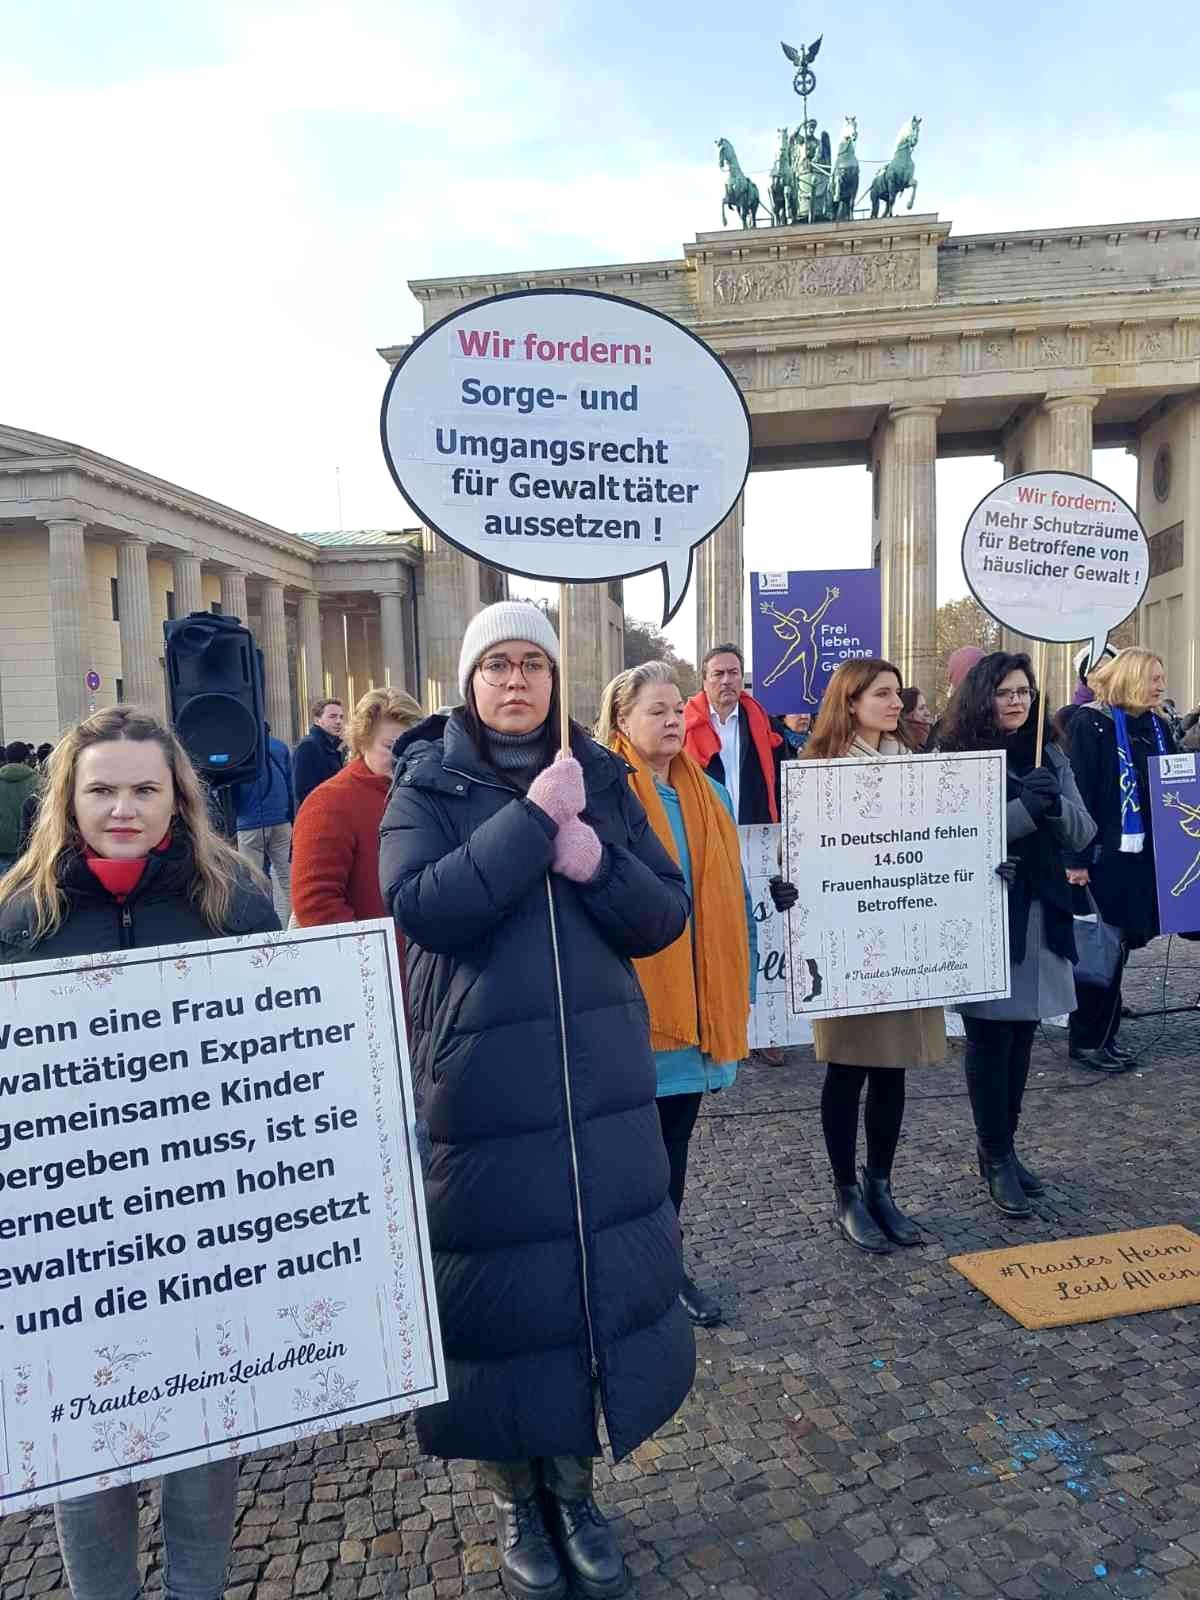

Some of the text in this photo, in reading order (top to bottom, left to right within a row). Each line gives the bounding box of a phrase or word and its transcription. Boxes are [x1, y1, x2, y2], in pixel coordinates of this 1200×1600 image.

[458, 330, 652, 365] Wir fordern:
[461, 378, 638, 414] Sorge- und
[436, 428, 669, 466] Umgangsrecht
[452, 468, 699, 504] für Gewalttäter
[1018, 486, 1117, 513] Wir fordern:
[485, 514, 662, 541] aussetzen !
[985, 511, 1139, 541] Mehr Schutzräume
[979, 532, 1128, 562] für Betroffene von
[983, 556, 1139, 585] häuslicher Gewalt !
[821, 624, 847, 635] Frei
[822, 637, 860, 647] leben
[839, 648, 872, 659] ohne
[820, 825, 978, 848] In Deutschland fehlen
[874, 850, 924, 866] 14.600
[822, 868, 975, 893] Frauenhausplätze für
[857, 896, 938, 914] Betroffene.
[89, 1007, 162, 1037] eine
[172, 996, 245, 1026] Frau
[255, 983, 322, 1013] dem
[200, 1020, 356, 1066] Expartner
[0, 1067, 325, 1151] gemeinsame Kinder
[161, 1124, 256, 1163] muss,
[267, 1113, 306, 1143] ist
[314, 1105, 358, 1131] sie
[0, 1157, 335, 1240] erneut einem hohen
[197, 1191, 371, 1248] ausgesetzt
[1000, 1244, 1191, 1279] #Trautes Heim
[16, 1295, 83, 1335] und
[94, 1285, 147, 1319] die
[158, 1260, 267, 1305] Kinder
[277, 1238, 363, 1280] auch!
[1054, 1267, 1200, 1301] Leid Allein
